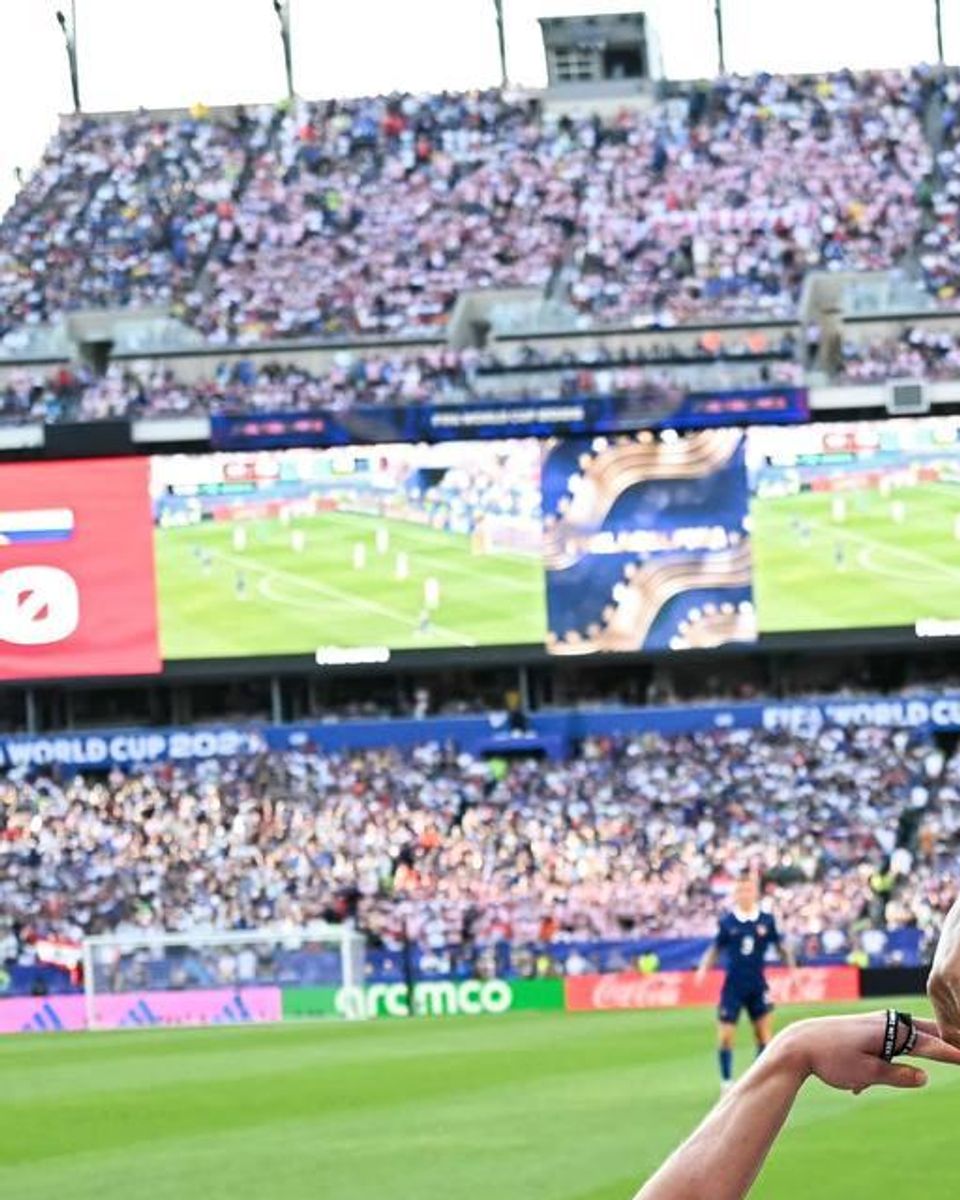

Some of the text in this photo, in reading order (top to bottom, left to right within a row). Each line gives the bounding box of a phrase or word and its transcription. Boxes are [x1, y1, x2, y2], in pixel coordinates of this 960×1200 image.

[826, 702, 928, 725] WORLD
[7, 740, 107, 767] WORLD
[110, 735, 166, 761] CUP
